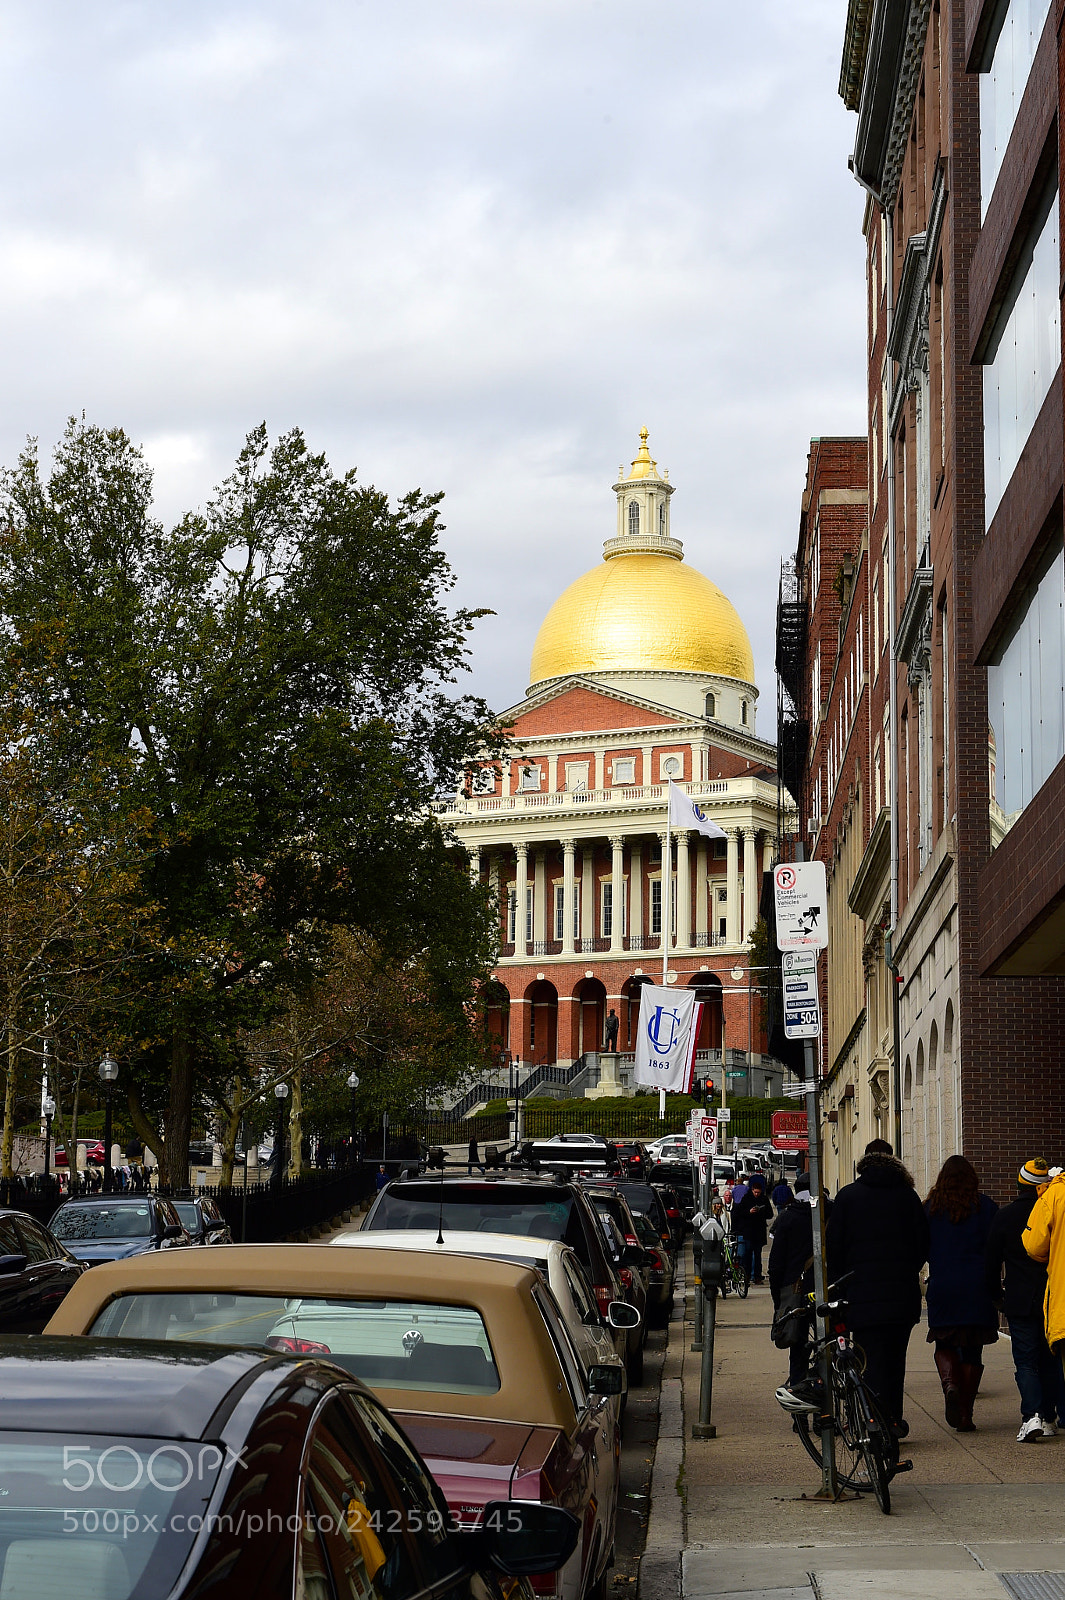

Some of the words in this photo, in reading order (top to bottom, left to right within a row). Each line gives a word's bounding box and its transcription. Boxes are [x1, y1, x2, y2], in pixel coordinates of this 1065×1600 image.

[777, 893, 808, 901] Commercial
[800, 1010, 817, 1024] 504
[648, 1058, 670, 1070] 1863
[460, 1505, 485, 1514] LINCO
